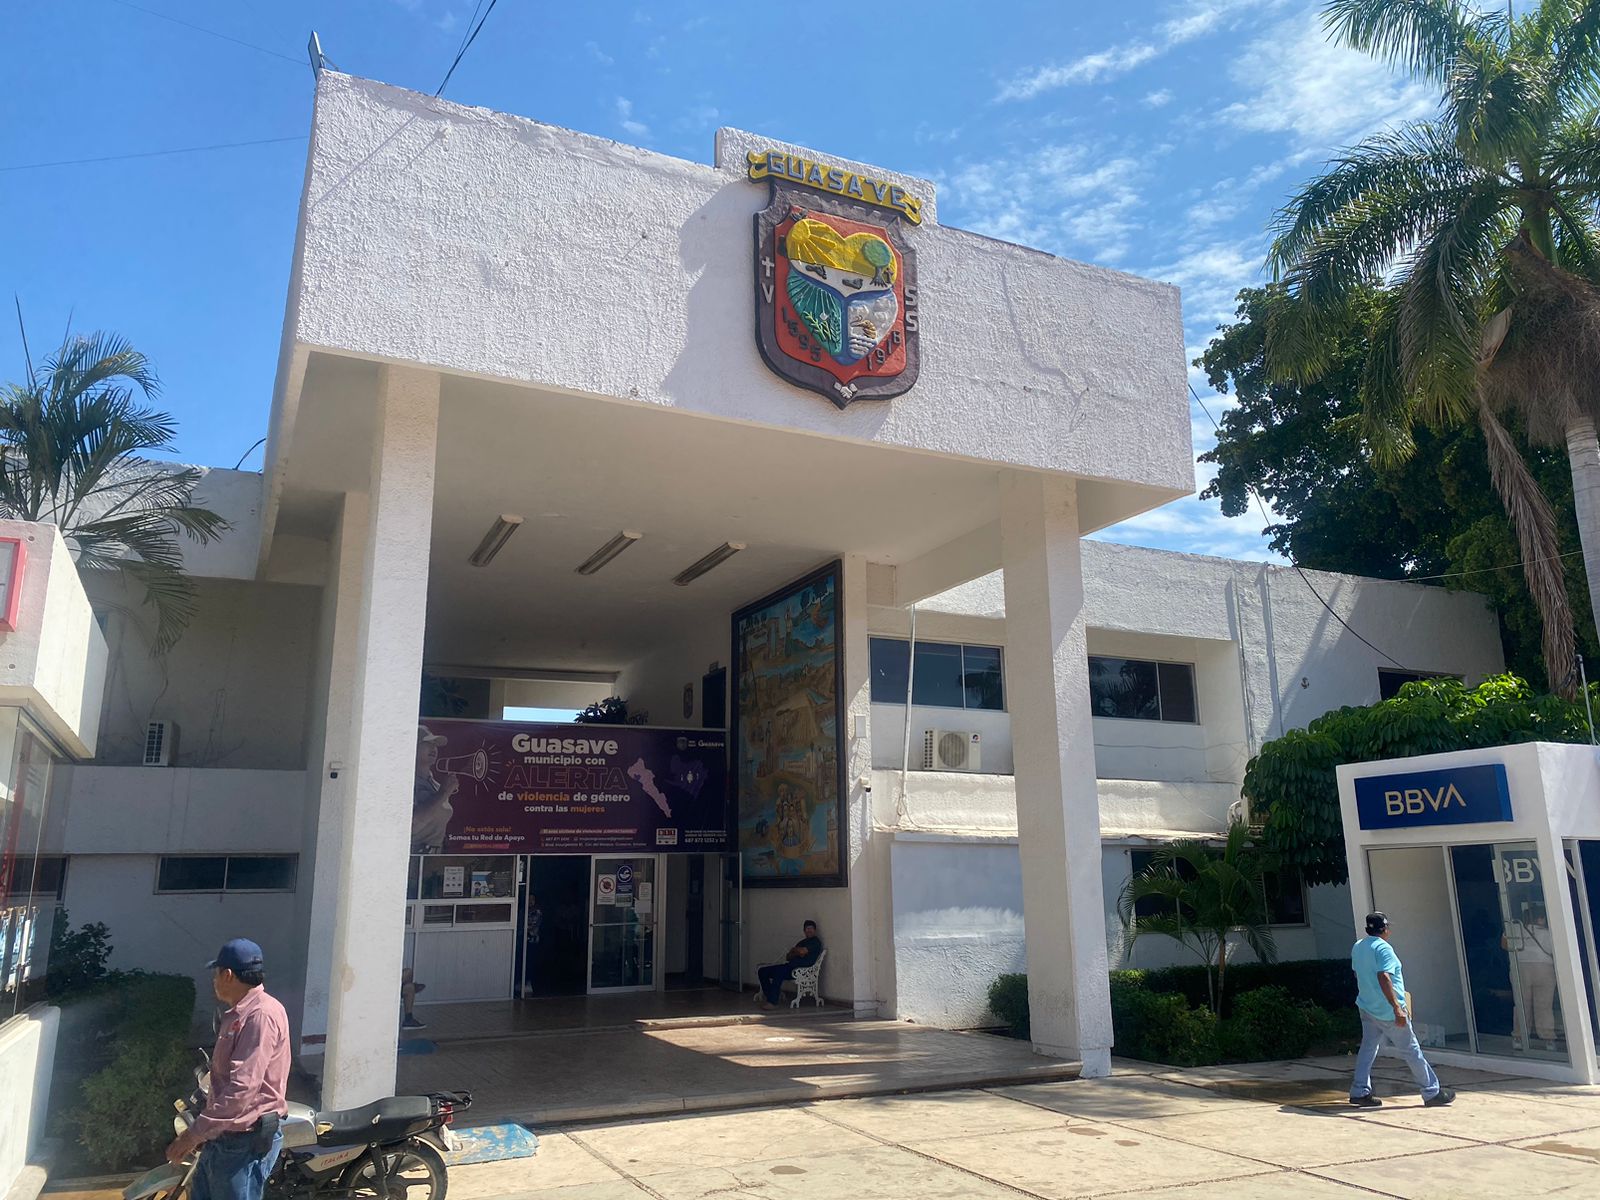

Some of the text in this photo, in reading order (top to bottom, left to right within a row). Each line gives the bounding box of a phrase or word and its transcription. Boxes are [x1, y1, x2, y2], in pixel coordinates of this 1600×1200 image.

[767, 152, 907, 208] GUASAVE
[511, 733, 619, 755] Guasave
[524, 754, 606, 766] municipio con
[504, 765, 630, 790] ALERTA
[498, 791, 631, 803] de violencia de género
[1384, 783, 1467, 816] BBVA
[524, 804, 606, 815] contra las mujeres
[504, 834, 525, 842] Apoyo
